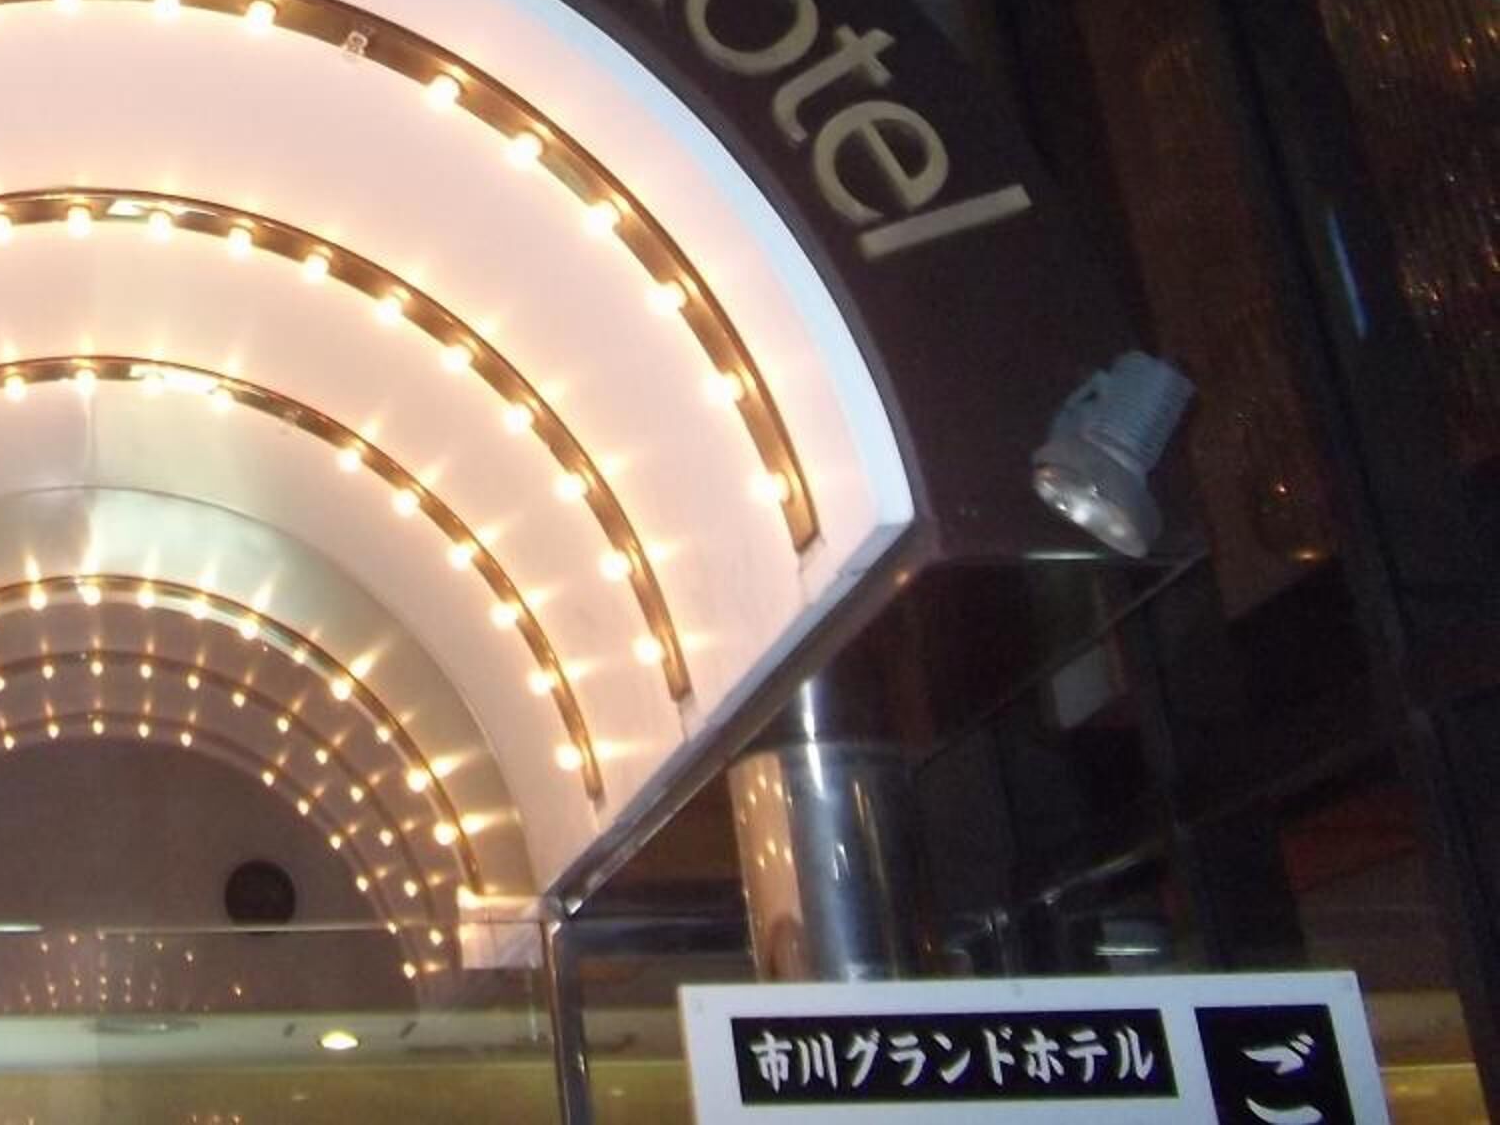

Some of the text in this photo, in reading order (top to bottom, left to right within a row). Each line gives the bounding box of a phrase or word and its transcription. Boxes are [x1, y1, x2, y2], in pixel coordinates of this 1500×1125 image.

[749, 1025, 1154, 1093] 市川グランドホテル
